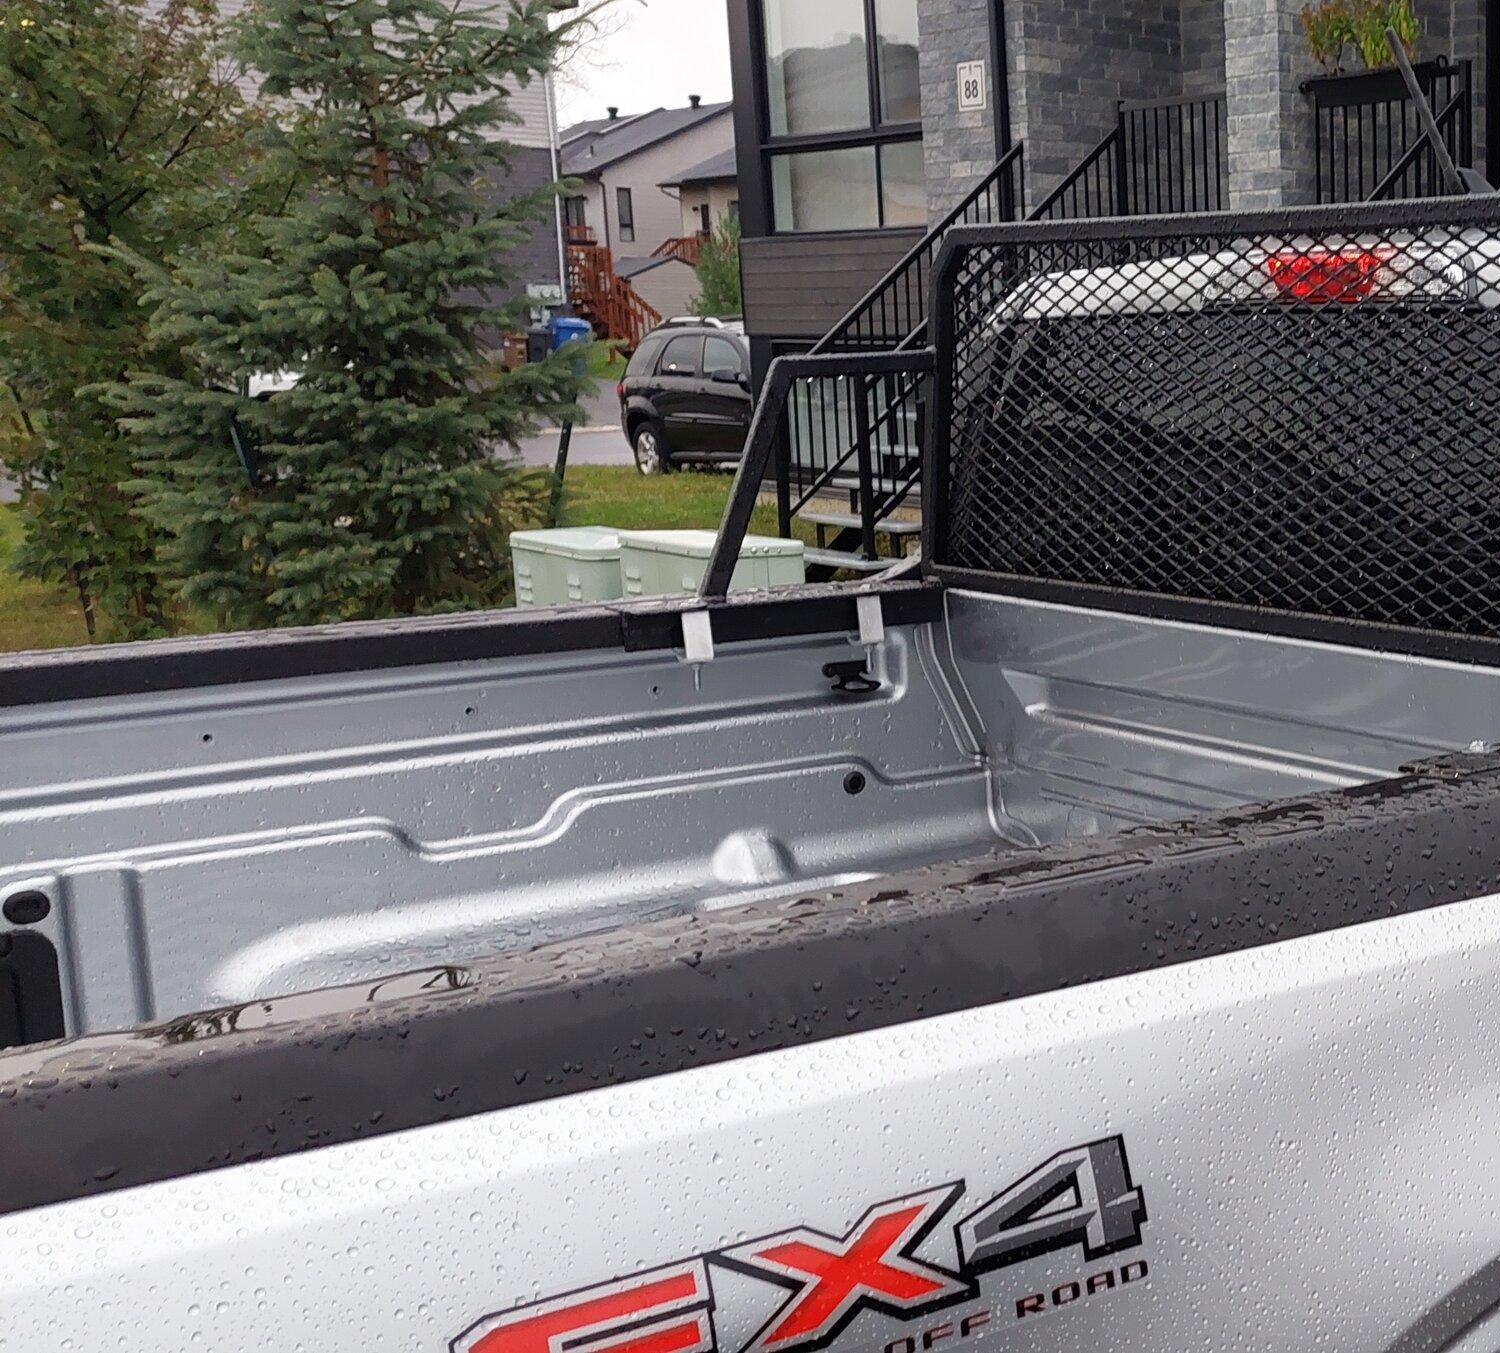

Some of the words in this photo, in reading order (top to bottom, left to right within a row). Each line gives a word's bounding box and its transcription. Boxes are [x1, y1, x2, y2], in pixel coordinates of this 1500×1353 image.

[964, 79, 979, 99] 88
[884, 1309, 991, 1353] OFF
[1015, 1259, 1149, 1319] ROAD
